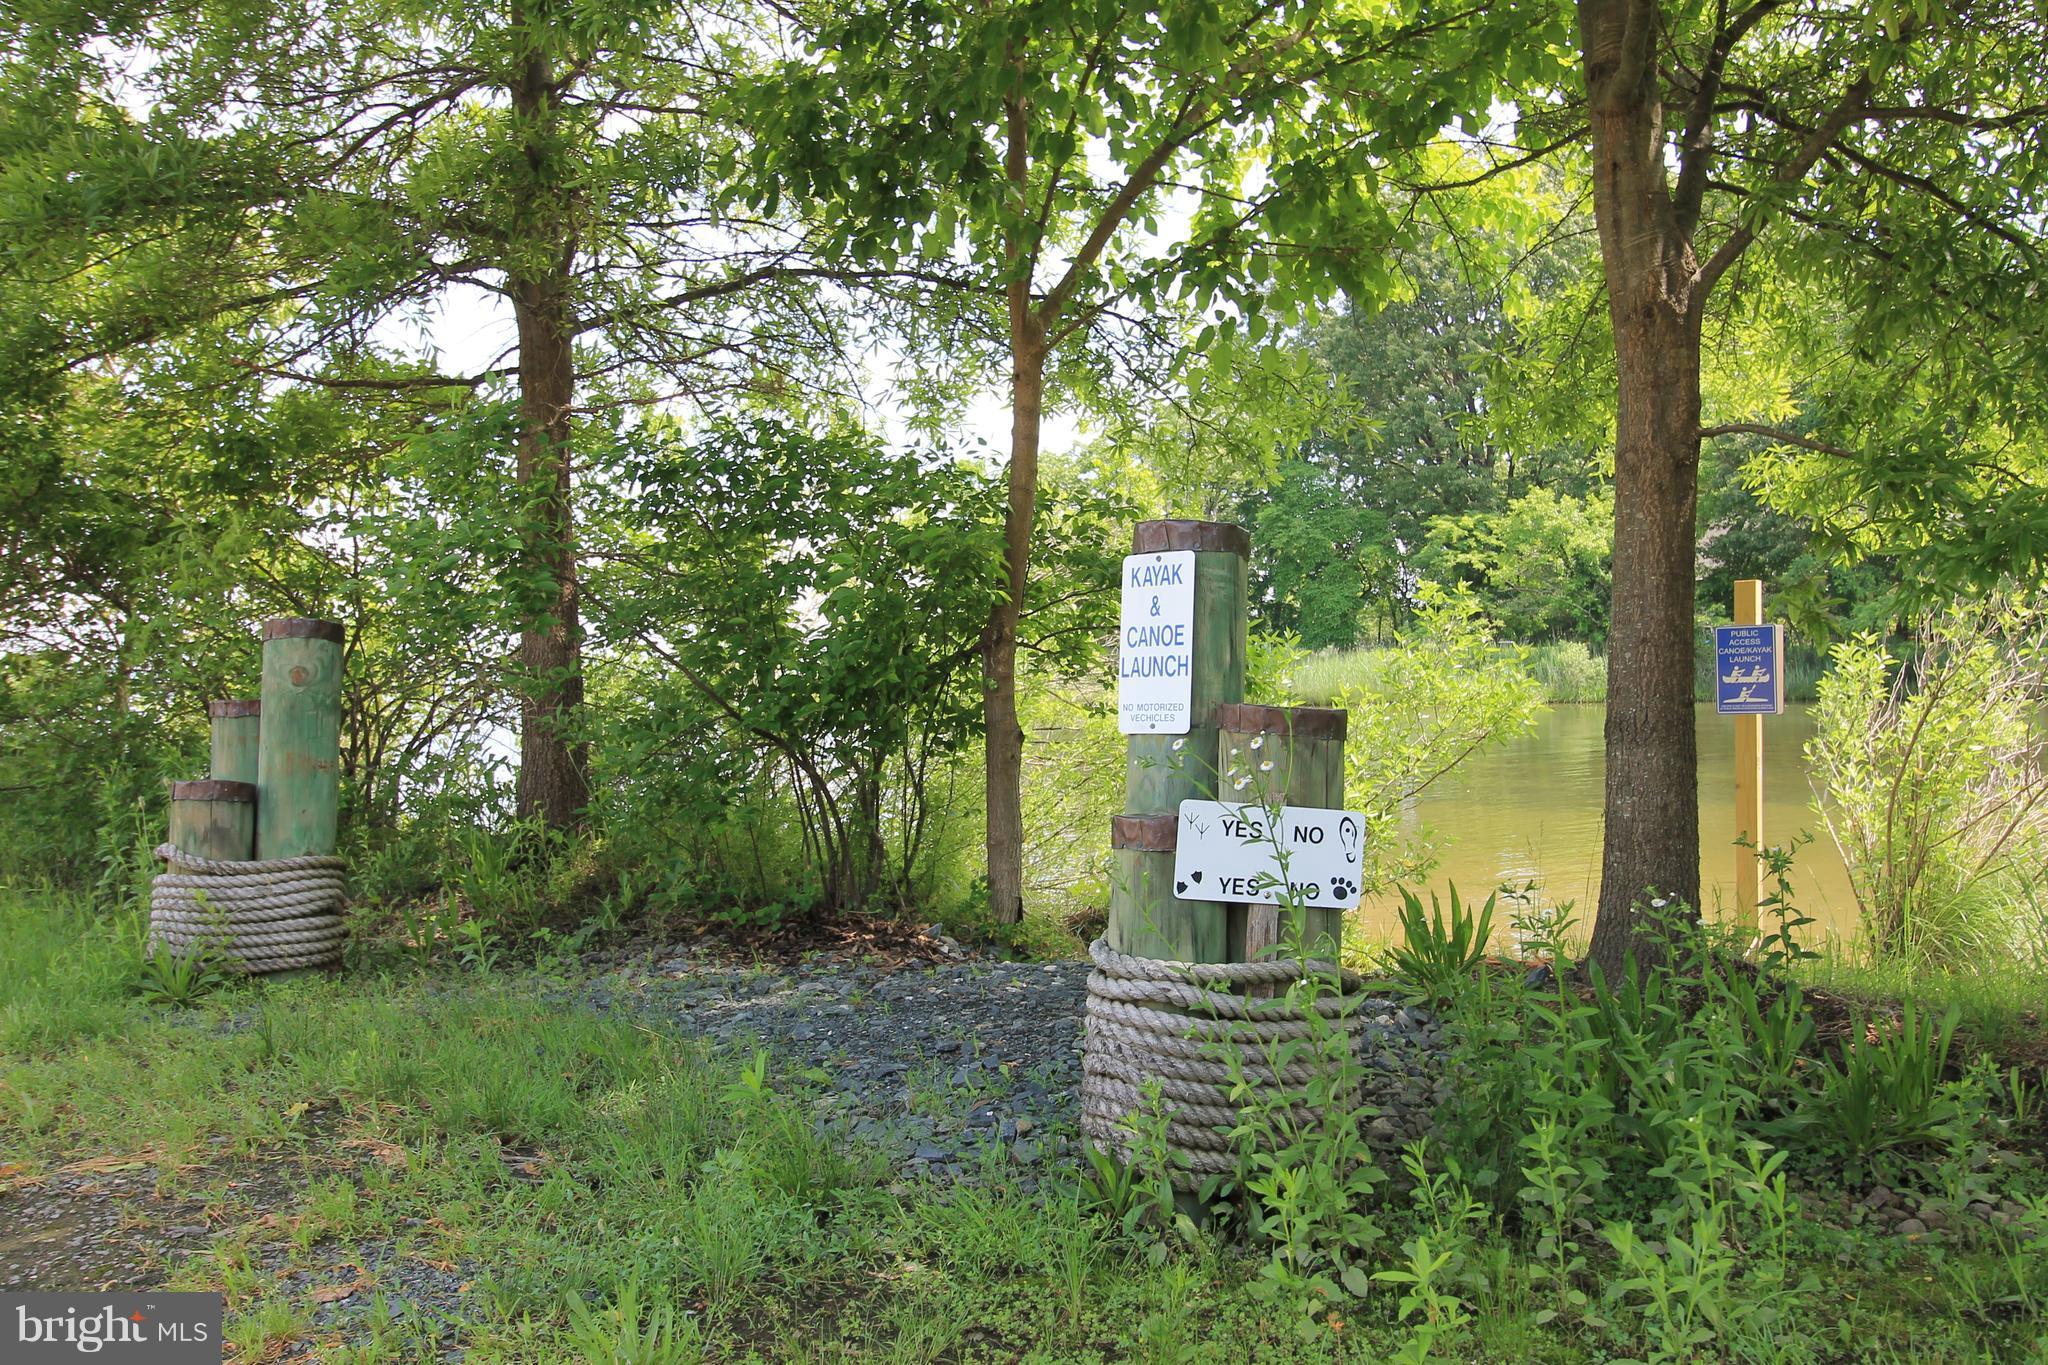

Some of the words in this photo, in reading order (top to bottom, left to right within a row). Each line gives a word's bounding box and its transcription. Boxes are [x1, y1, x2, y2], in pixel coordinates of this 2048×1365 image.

[1131, 563, 1183, 588] KAYAK
[1150, 595, 1161, 617] &
[1127, 624, 1185, 648] CANOE
[1729, 638, 1761, 646] ACCESS
[1719, 646, 1772, 655] CANOE/KAYAK
[1121, 655, 1189, 678] LAUNCH
[1123, 703, 1134, 712] NO
[1137, 702, 1184, 712] MOTORIZED
[1130, 713, 1175, 722] VECHICLES
[1222, 819, 1263, 839] YES
[1294, 825, 1324, 844] NO
[1219, 877, 1259, 896] YES
